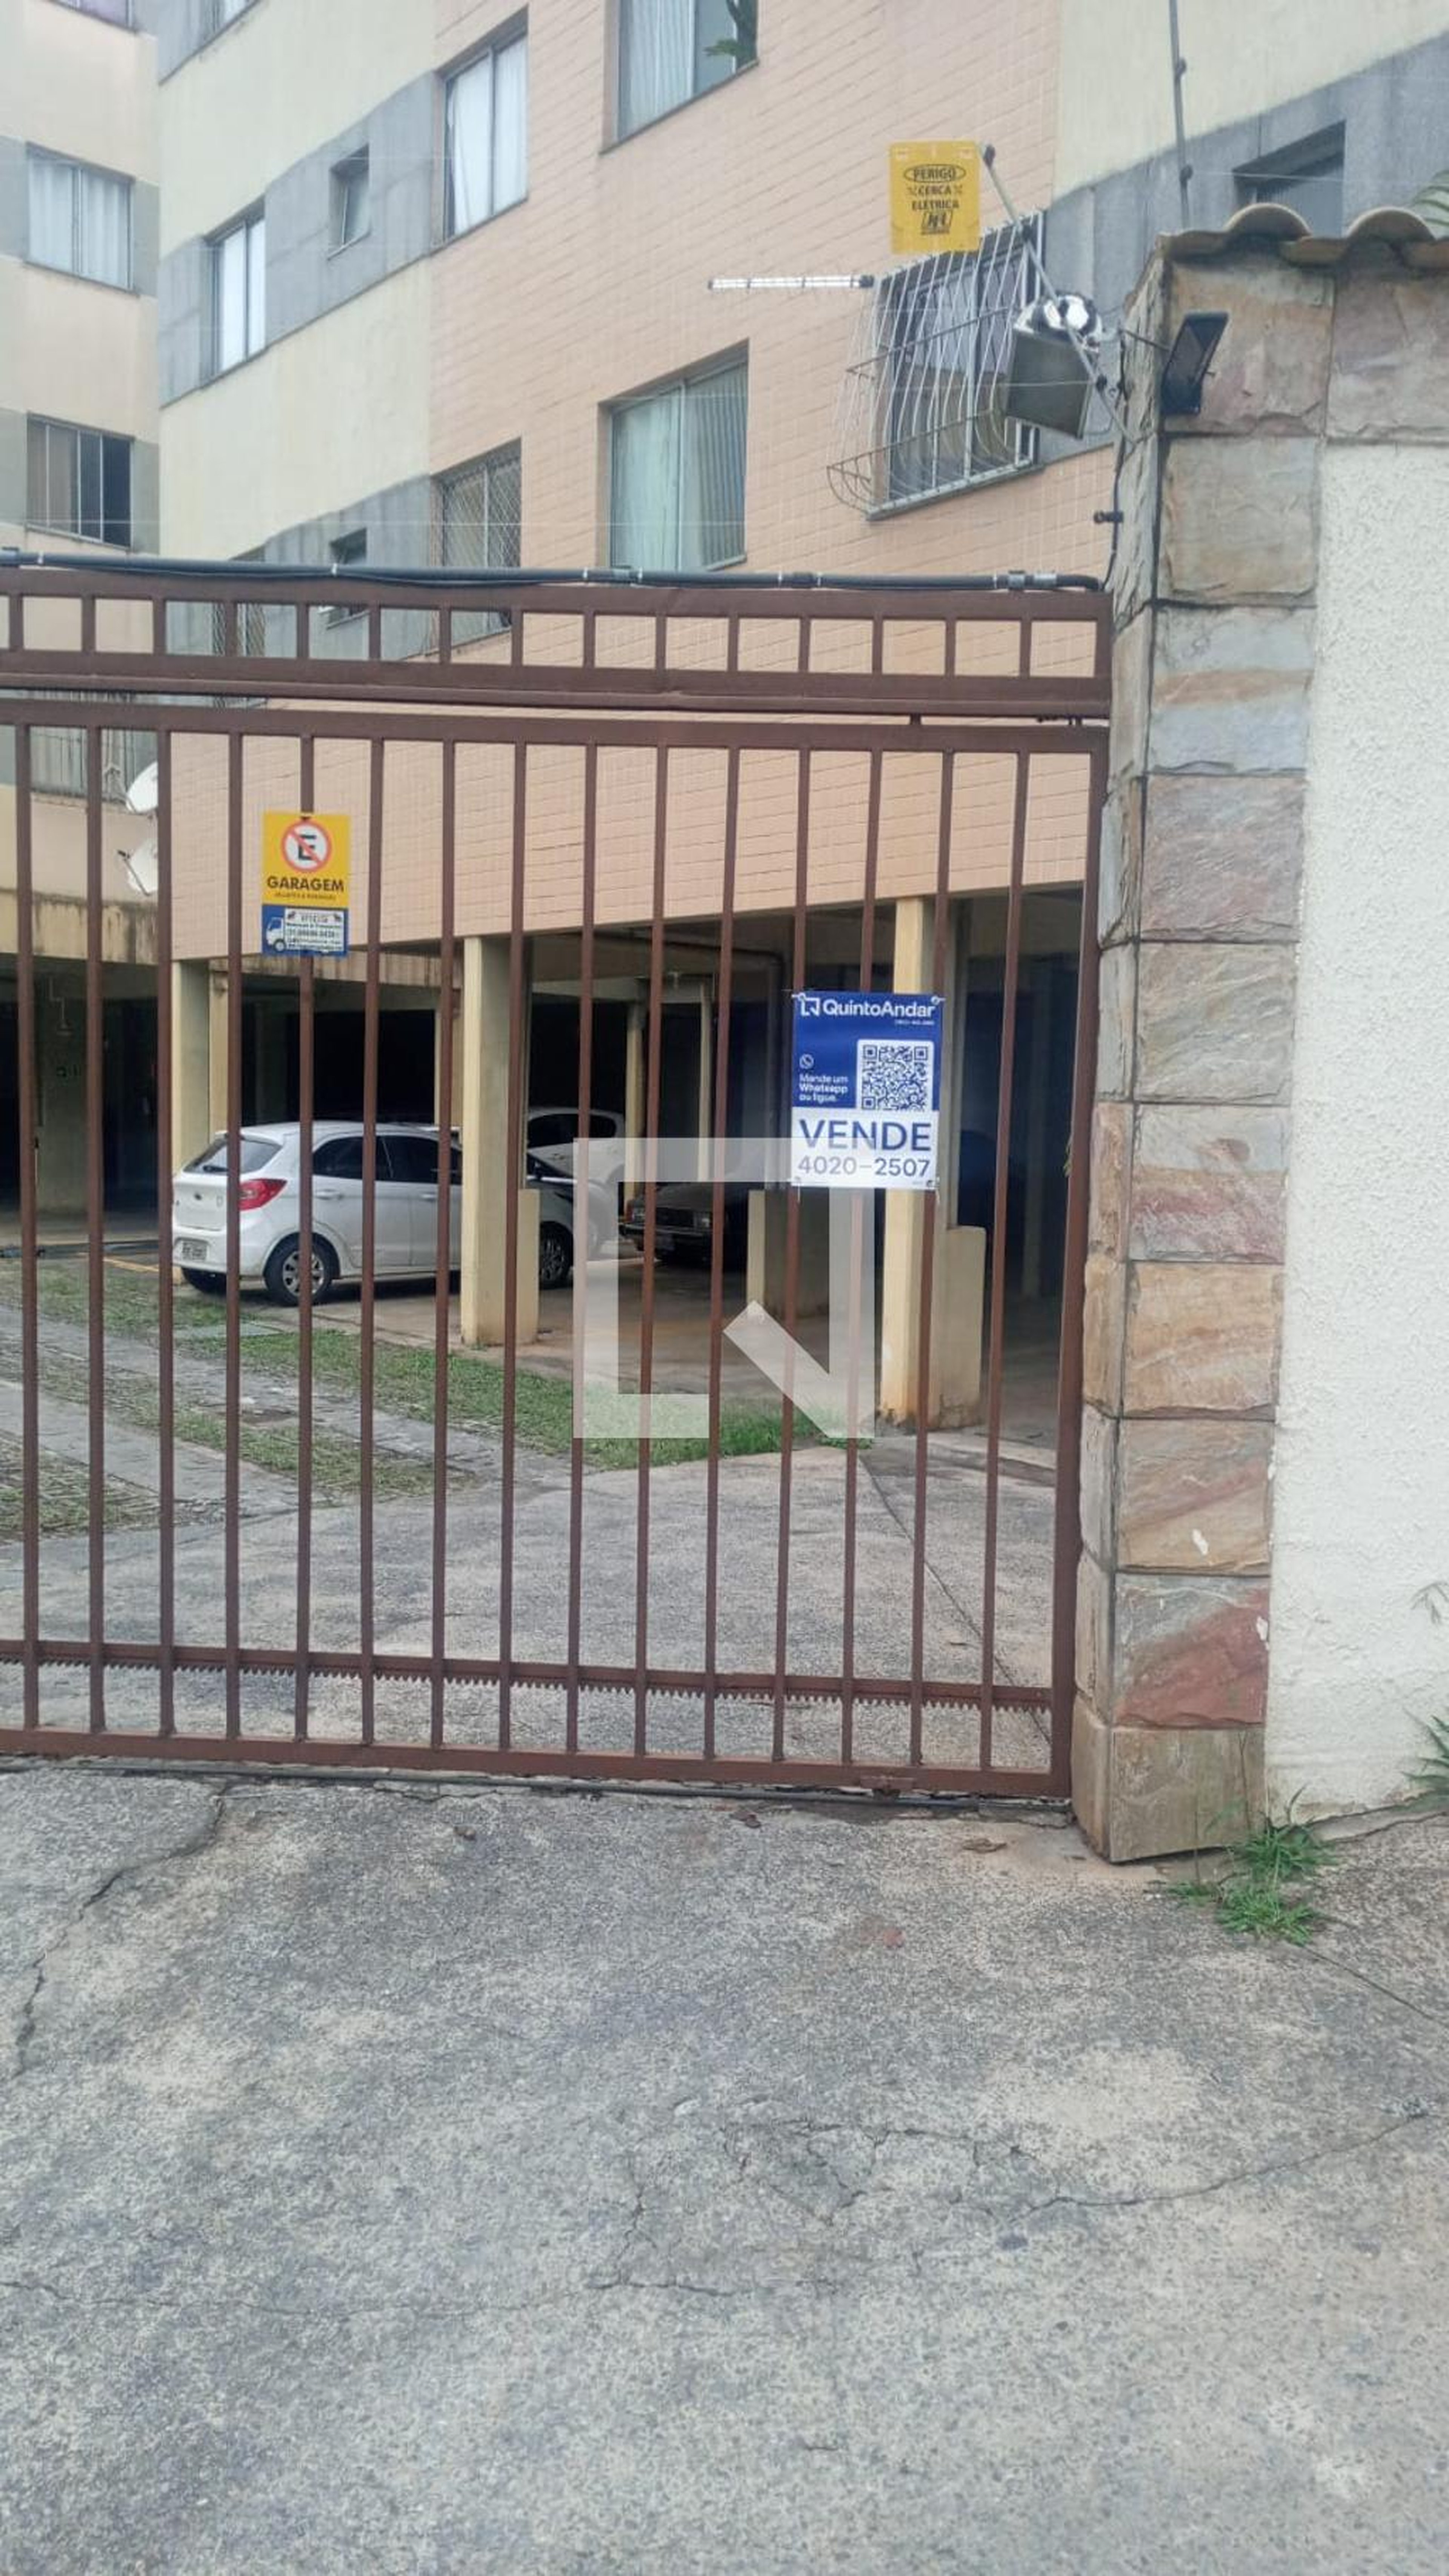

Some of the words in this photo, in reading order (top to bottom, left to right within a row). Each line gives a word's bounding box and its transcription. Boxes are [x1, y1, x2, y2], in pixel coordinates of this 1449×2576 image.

[914, 168, 956, 181] PERIGO
[267, 876, 344, 892] GARAGEM
[823, 999, 935, 1017] QuintoAndar
[799, 1119, 932, 1151] VENDE
[798, 1156, 931, 1177] 4020-2507
